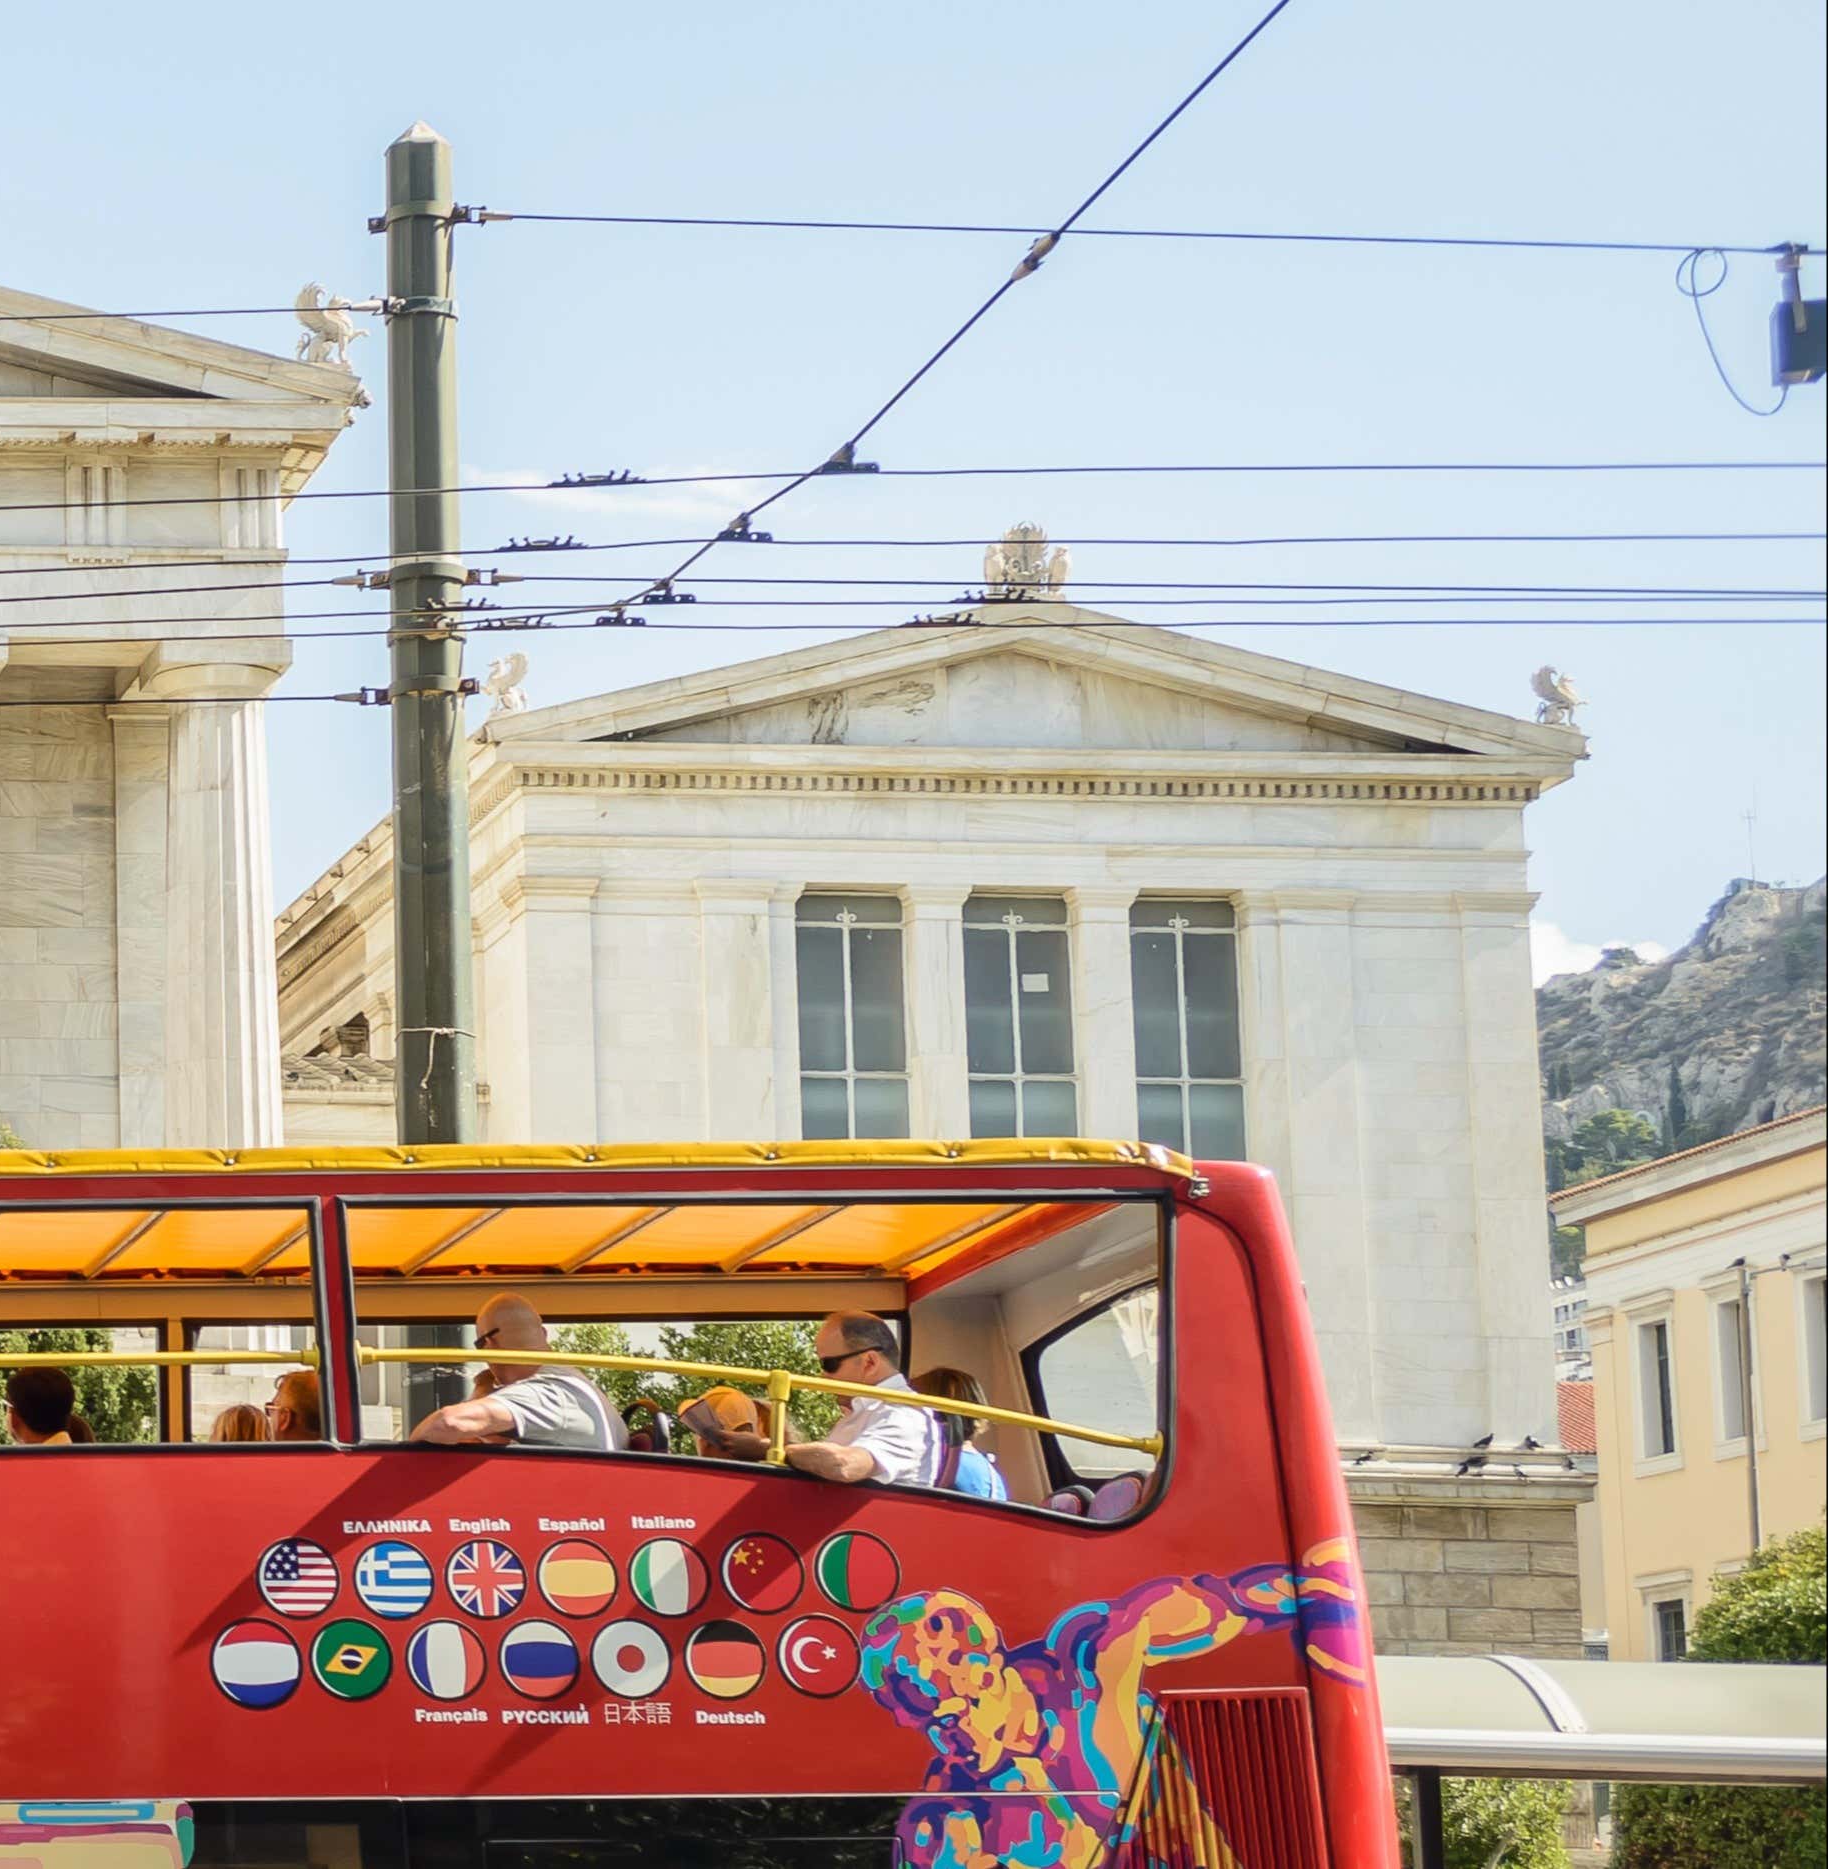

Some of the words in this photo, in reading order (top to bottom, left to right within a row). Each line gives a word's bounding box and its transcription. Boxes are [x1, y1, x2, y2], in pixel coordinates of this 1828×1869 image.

[343, 1519, 433, 1534] ΕΛΛΗΝΙΚΑ
[448, 1517, 512, 1535] English
[538, 1516, 606, 1534] Español
[631, 1515, 696, 1530] Italiano
[414, 1708, 489, 1725] Français
[501, 1702, 590, 1725] РУССКИЙ
[603, 1699, 673, 1725] 日本語
[695, 1709, 766, 1725] Deutsch
